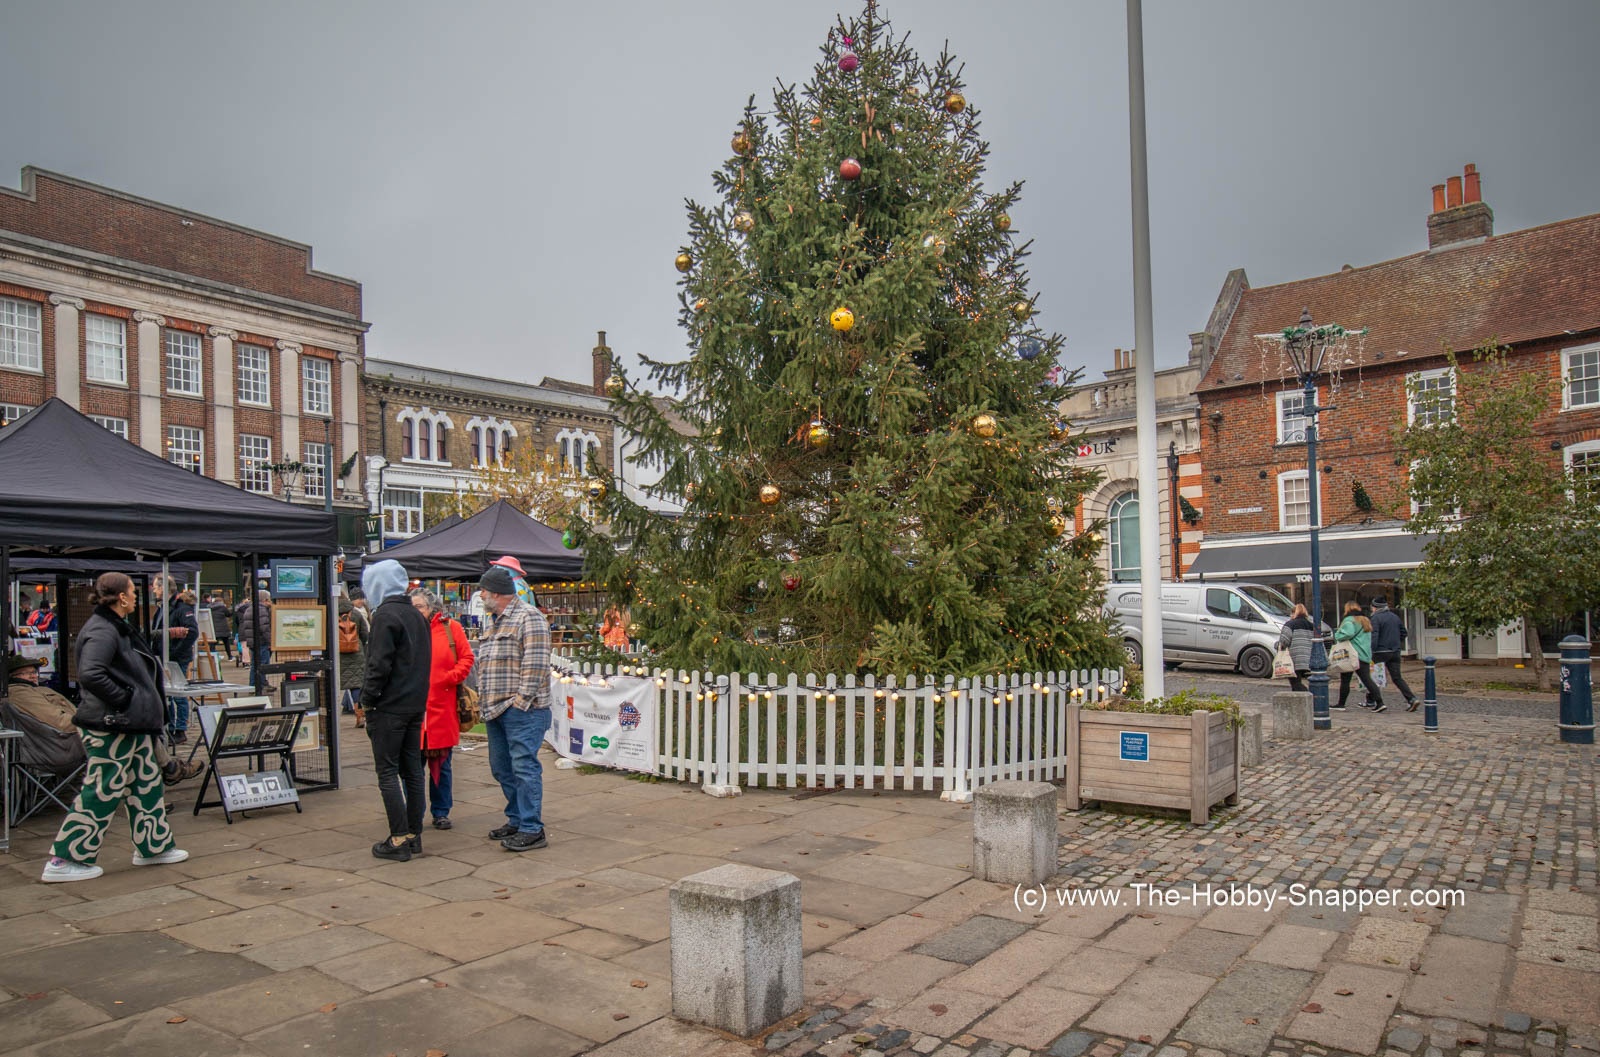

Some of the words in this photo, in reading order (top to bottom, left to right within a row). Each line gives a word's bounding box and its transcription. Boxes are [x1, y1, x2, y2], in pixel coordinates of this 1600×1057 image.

[1094, 441, 1115, 455] UK
[366, 520, 377, 533] W
[1295, 572, 1344, 583] TON&GUY
[278, 791, 292, 799] Art
